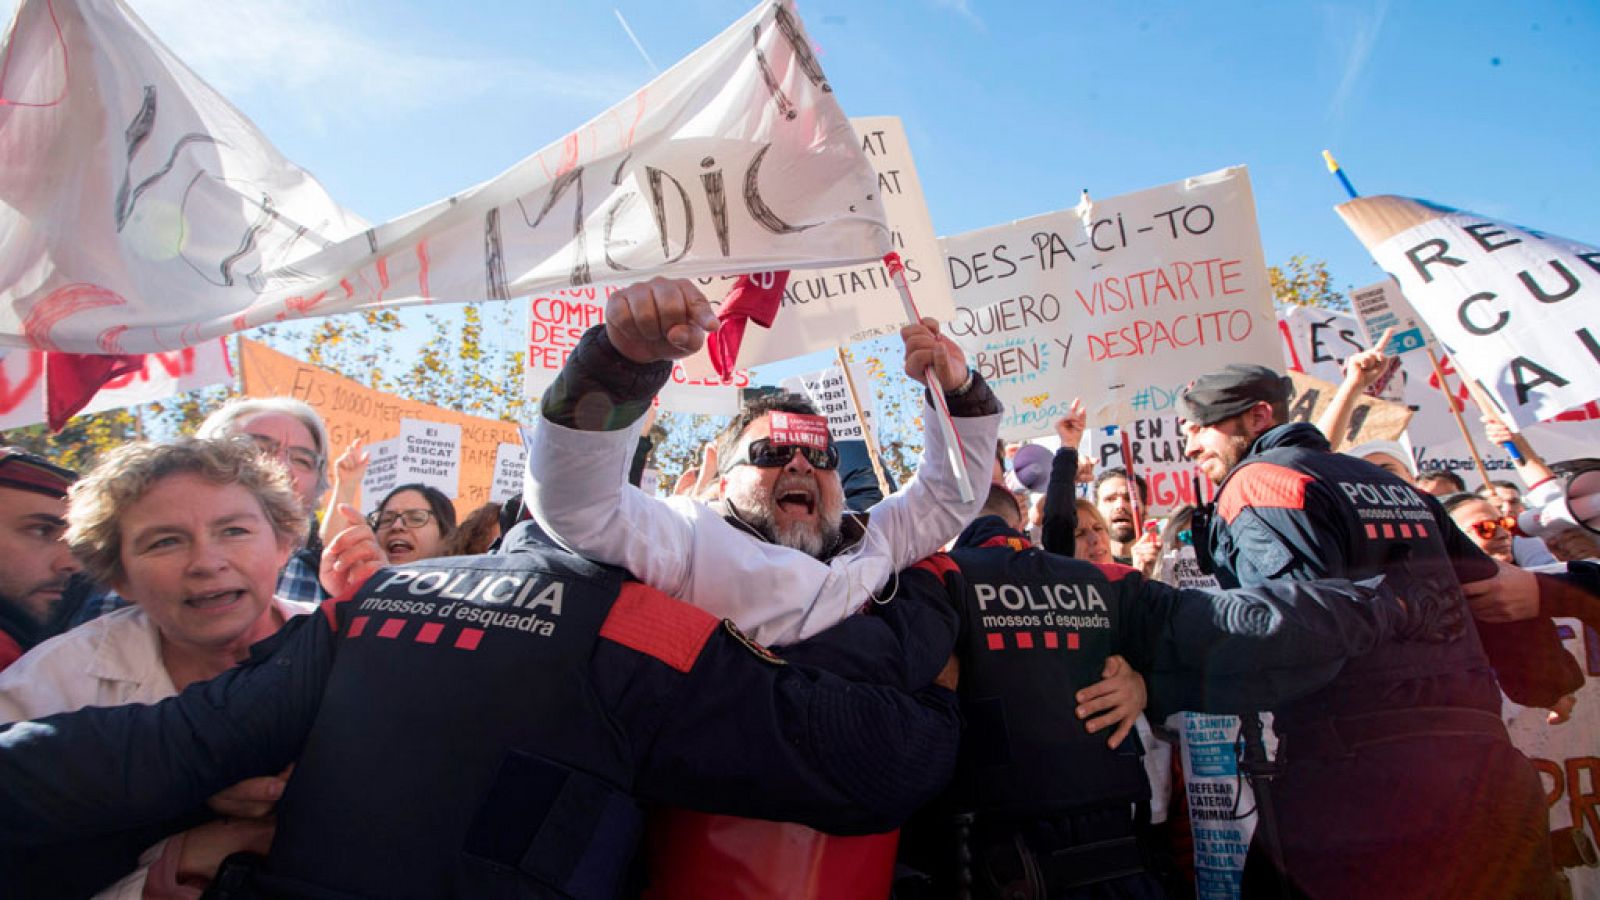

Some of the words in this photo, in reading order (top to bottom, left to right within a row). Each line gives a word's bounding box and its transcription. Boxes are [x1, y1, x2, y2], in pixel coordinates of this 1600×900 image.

[781, 258, 921, 308] ACULTATIS
[948, 293, 1061, 337] QUIERO
[1075, 257, 1246, 317] VISITARTE
[976, 342, 1040, 380] BIEN
[1055, 334, 1073, 368] Y
[1087, 309, 1253, 363] DESPACITO
[406, 435, 456, 449] Conveni
[407, 445, 453, 458] SISCAT
[408, 465, 449, 477] mullat
[421, 457, 456, 468] paper
[1338, 481, 1429, 509] POLICIA
[375, 568, 565, 616] POLICIA
[974, 583, 1108, 612] POLICIA
[360, 596, 436, 616] mossos
[983, 613, 1041, 628] mossos
